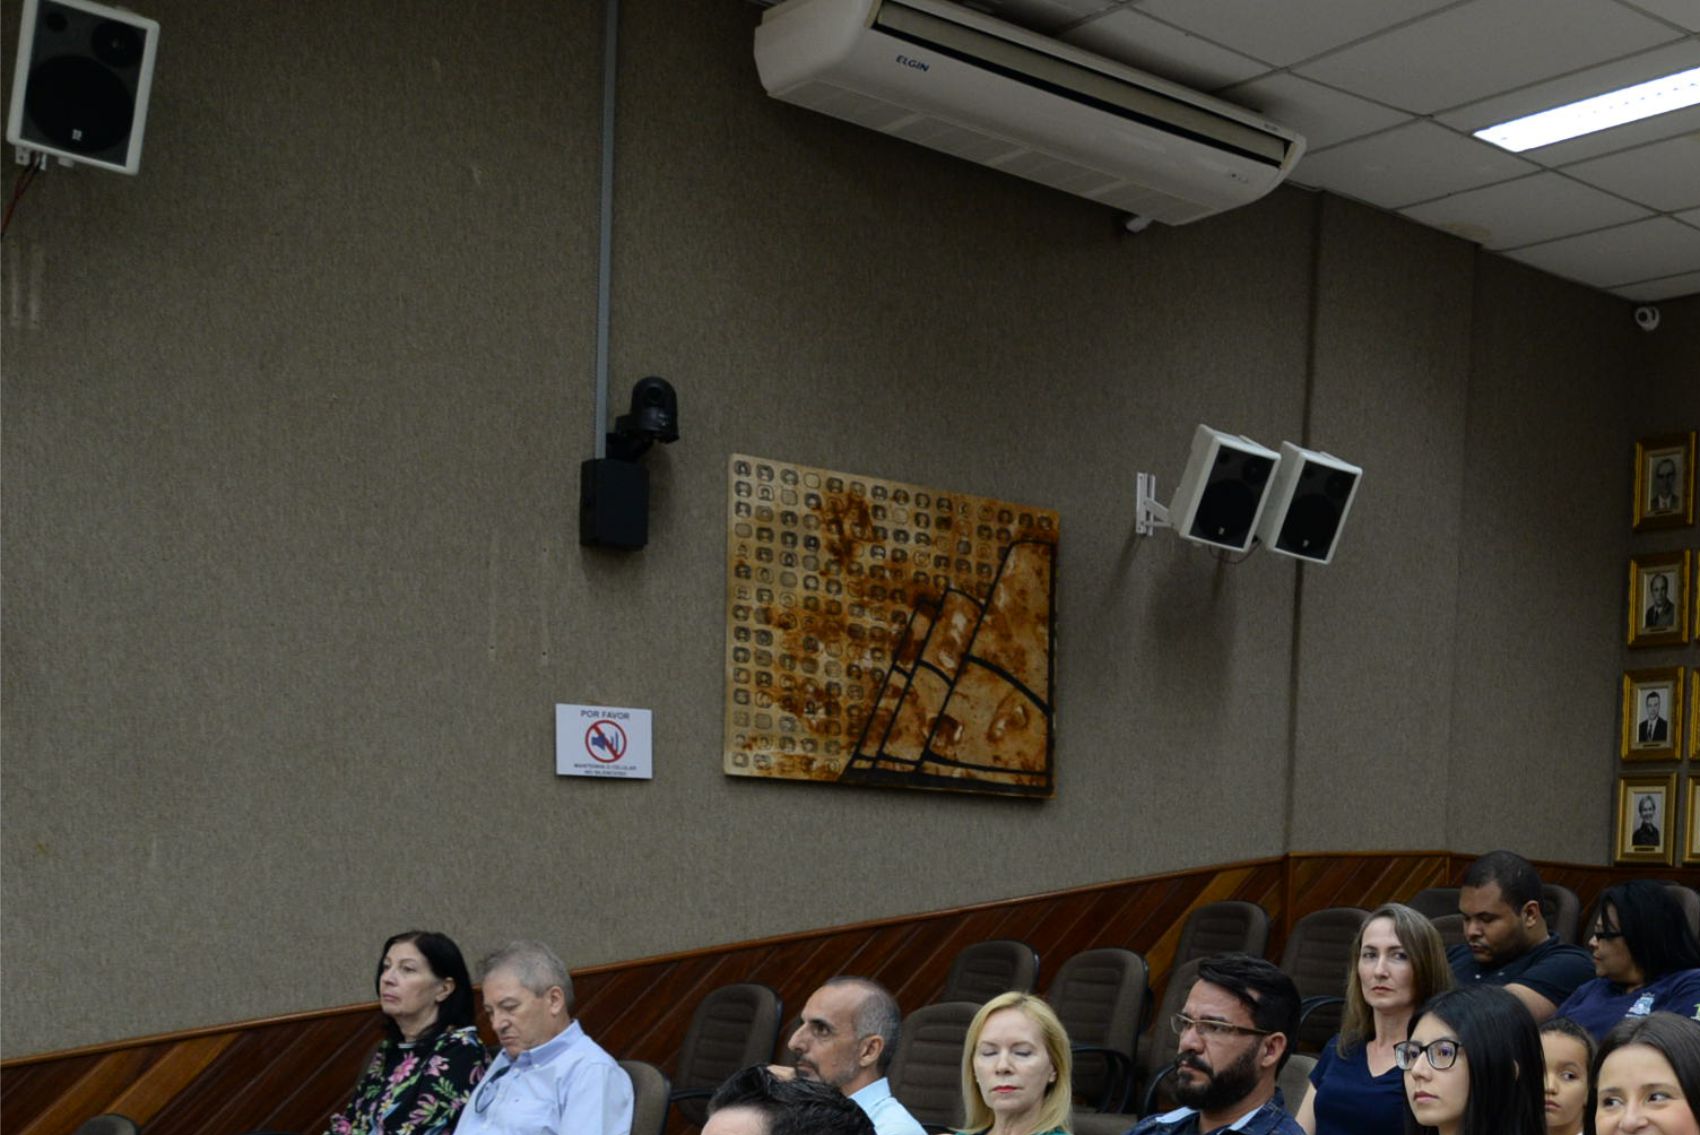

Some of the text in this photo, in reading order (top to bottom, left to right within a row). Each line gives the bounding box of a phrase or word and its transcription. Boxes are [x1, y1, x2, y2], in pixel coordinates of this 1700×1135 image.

[896, 55, 930, 72] ELGIN
[580, 710, 630, 719] POR FAVOR
